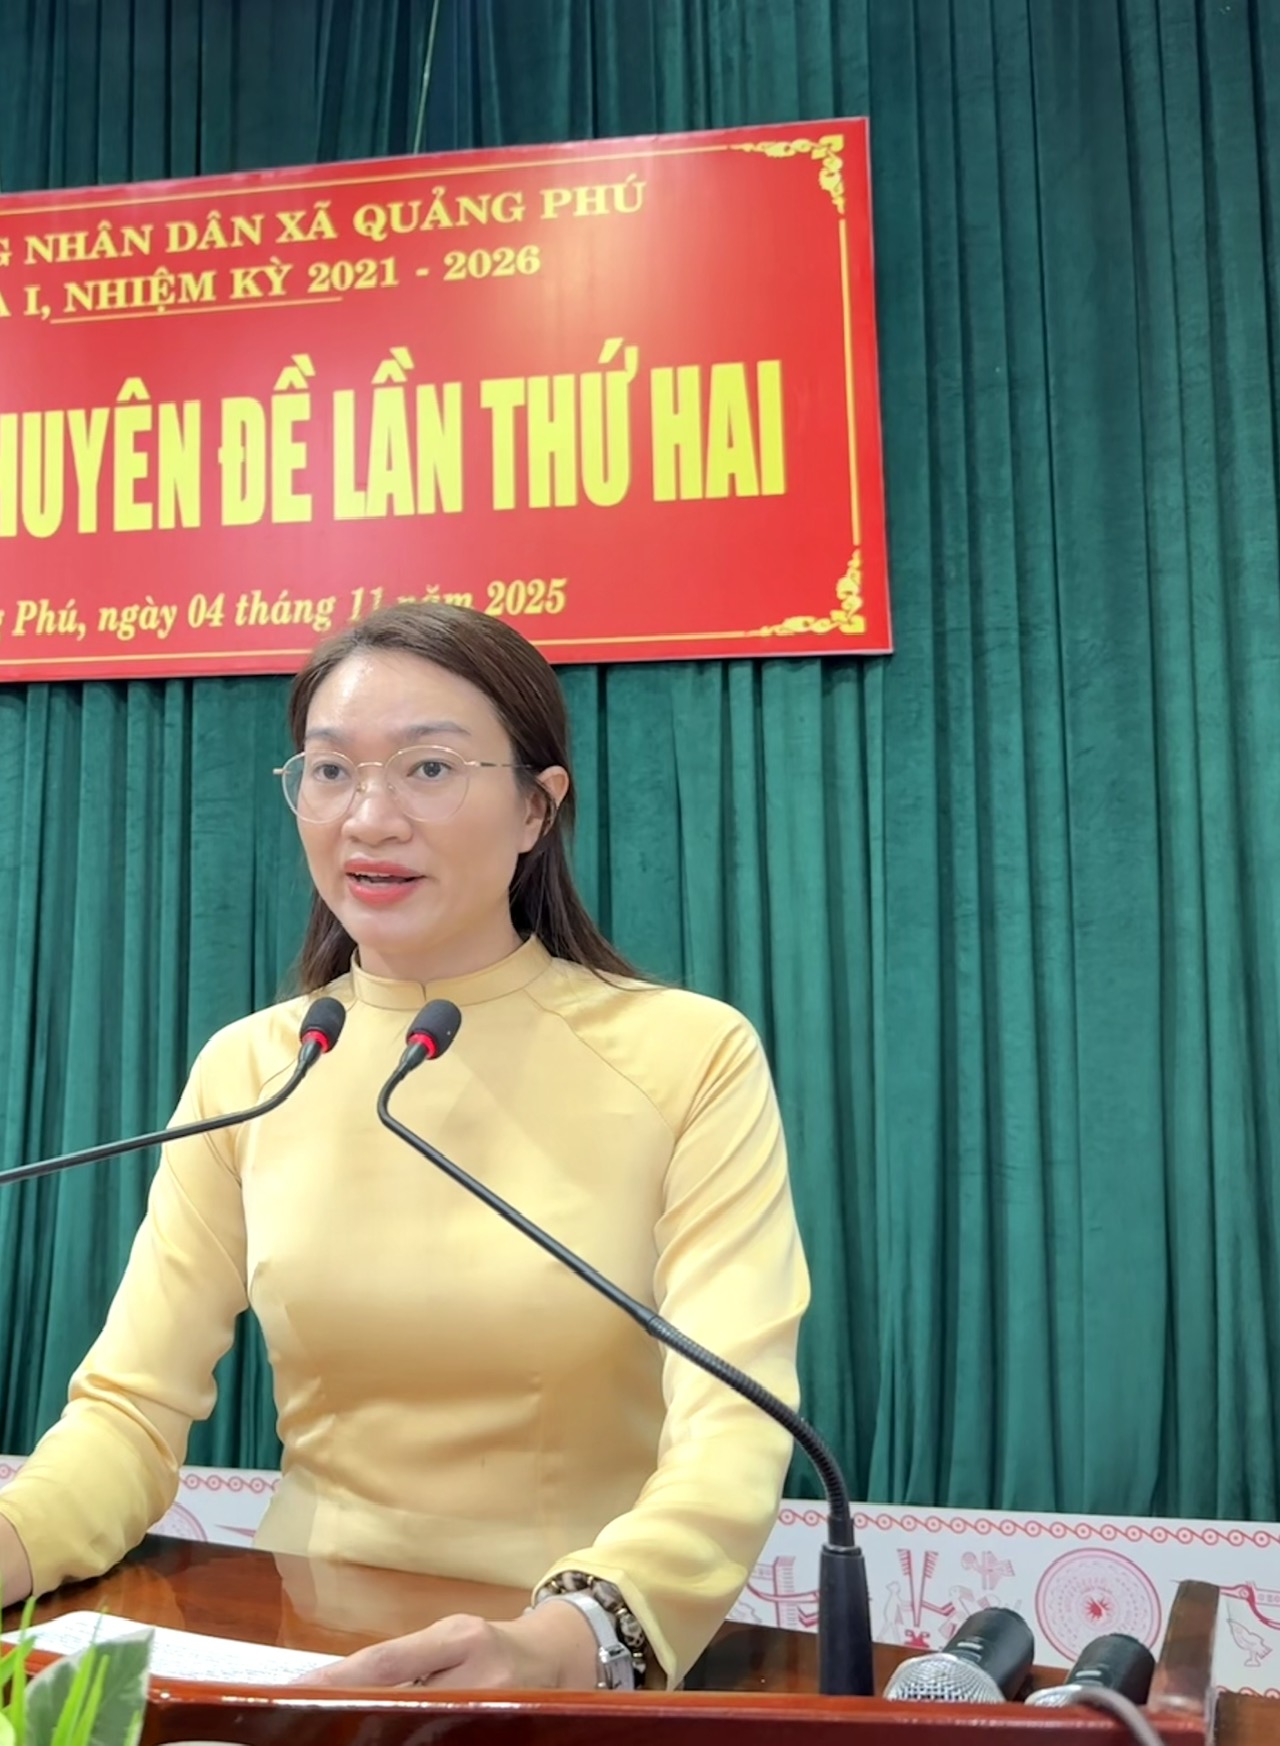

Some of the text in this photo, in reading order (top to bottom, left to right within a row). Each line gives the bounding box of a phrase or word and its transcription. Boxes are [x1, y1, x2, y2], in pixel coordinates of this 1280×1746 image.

[24, 219, 154, 265] NHÂN
[165, 209, 265, 253] DÂN
[275, 200, 338, 244] XÃ
[352, 185, 526, 242] QUẢNG
[540, 173, 647, 220] PHÚ
[23, 284, 52, 320] I,
[63, 265, 217, 314] NHIỆM
[229, 256, 293, 300] KỲ
[307, 256, 400, 293] 2021
[415, 266, 430, 277] -
[443, 245, 541, 282] 2026
[218, 354, 315, 526] ĐỀ
[333, 346, 464, 521] LẦN
[480, 337, 640, 511] THỨ
[650, 359, 786, 502] HAI
[11, 598, 87, 642] Phú,
[98, 595, 178, 640] ngày
[187, 593, 225, 628] 04
[234, 589, 337, 632] tháng
[350, 586, 384, 622] 11
[486, 578, 567, 616] 2025
